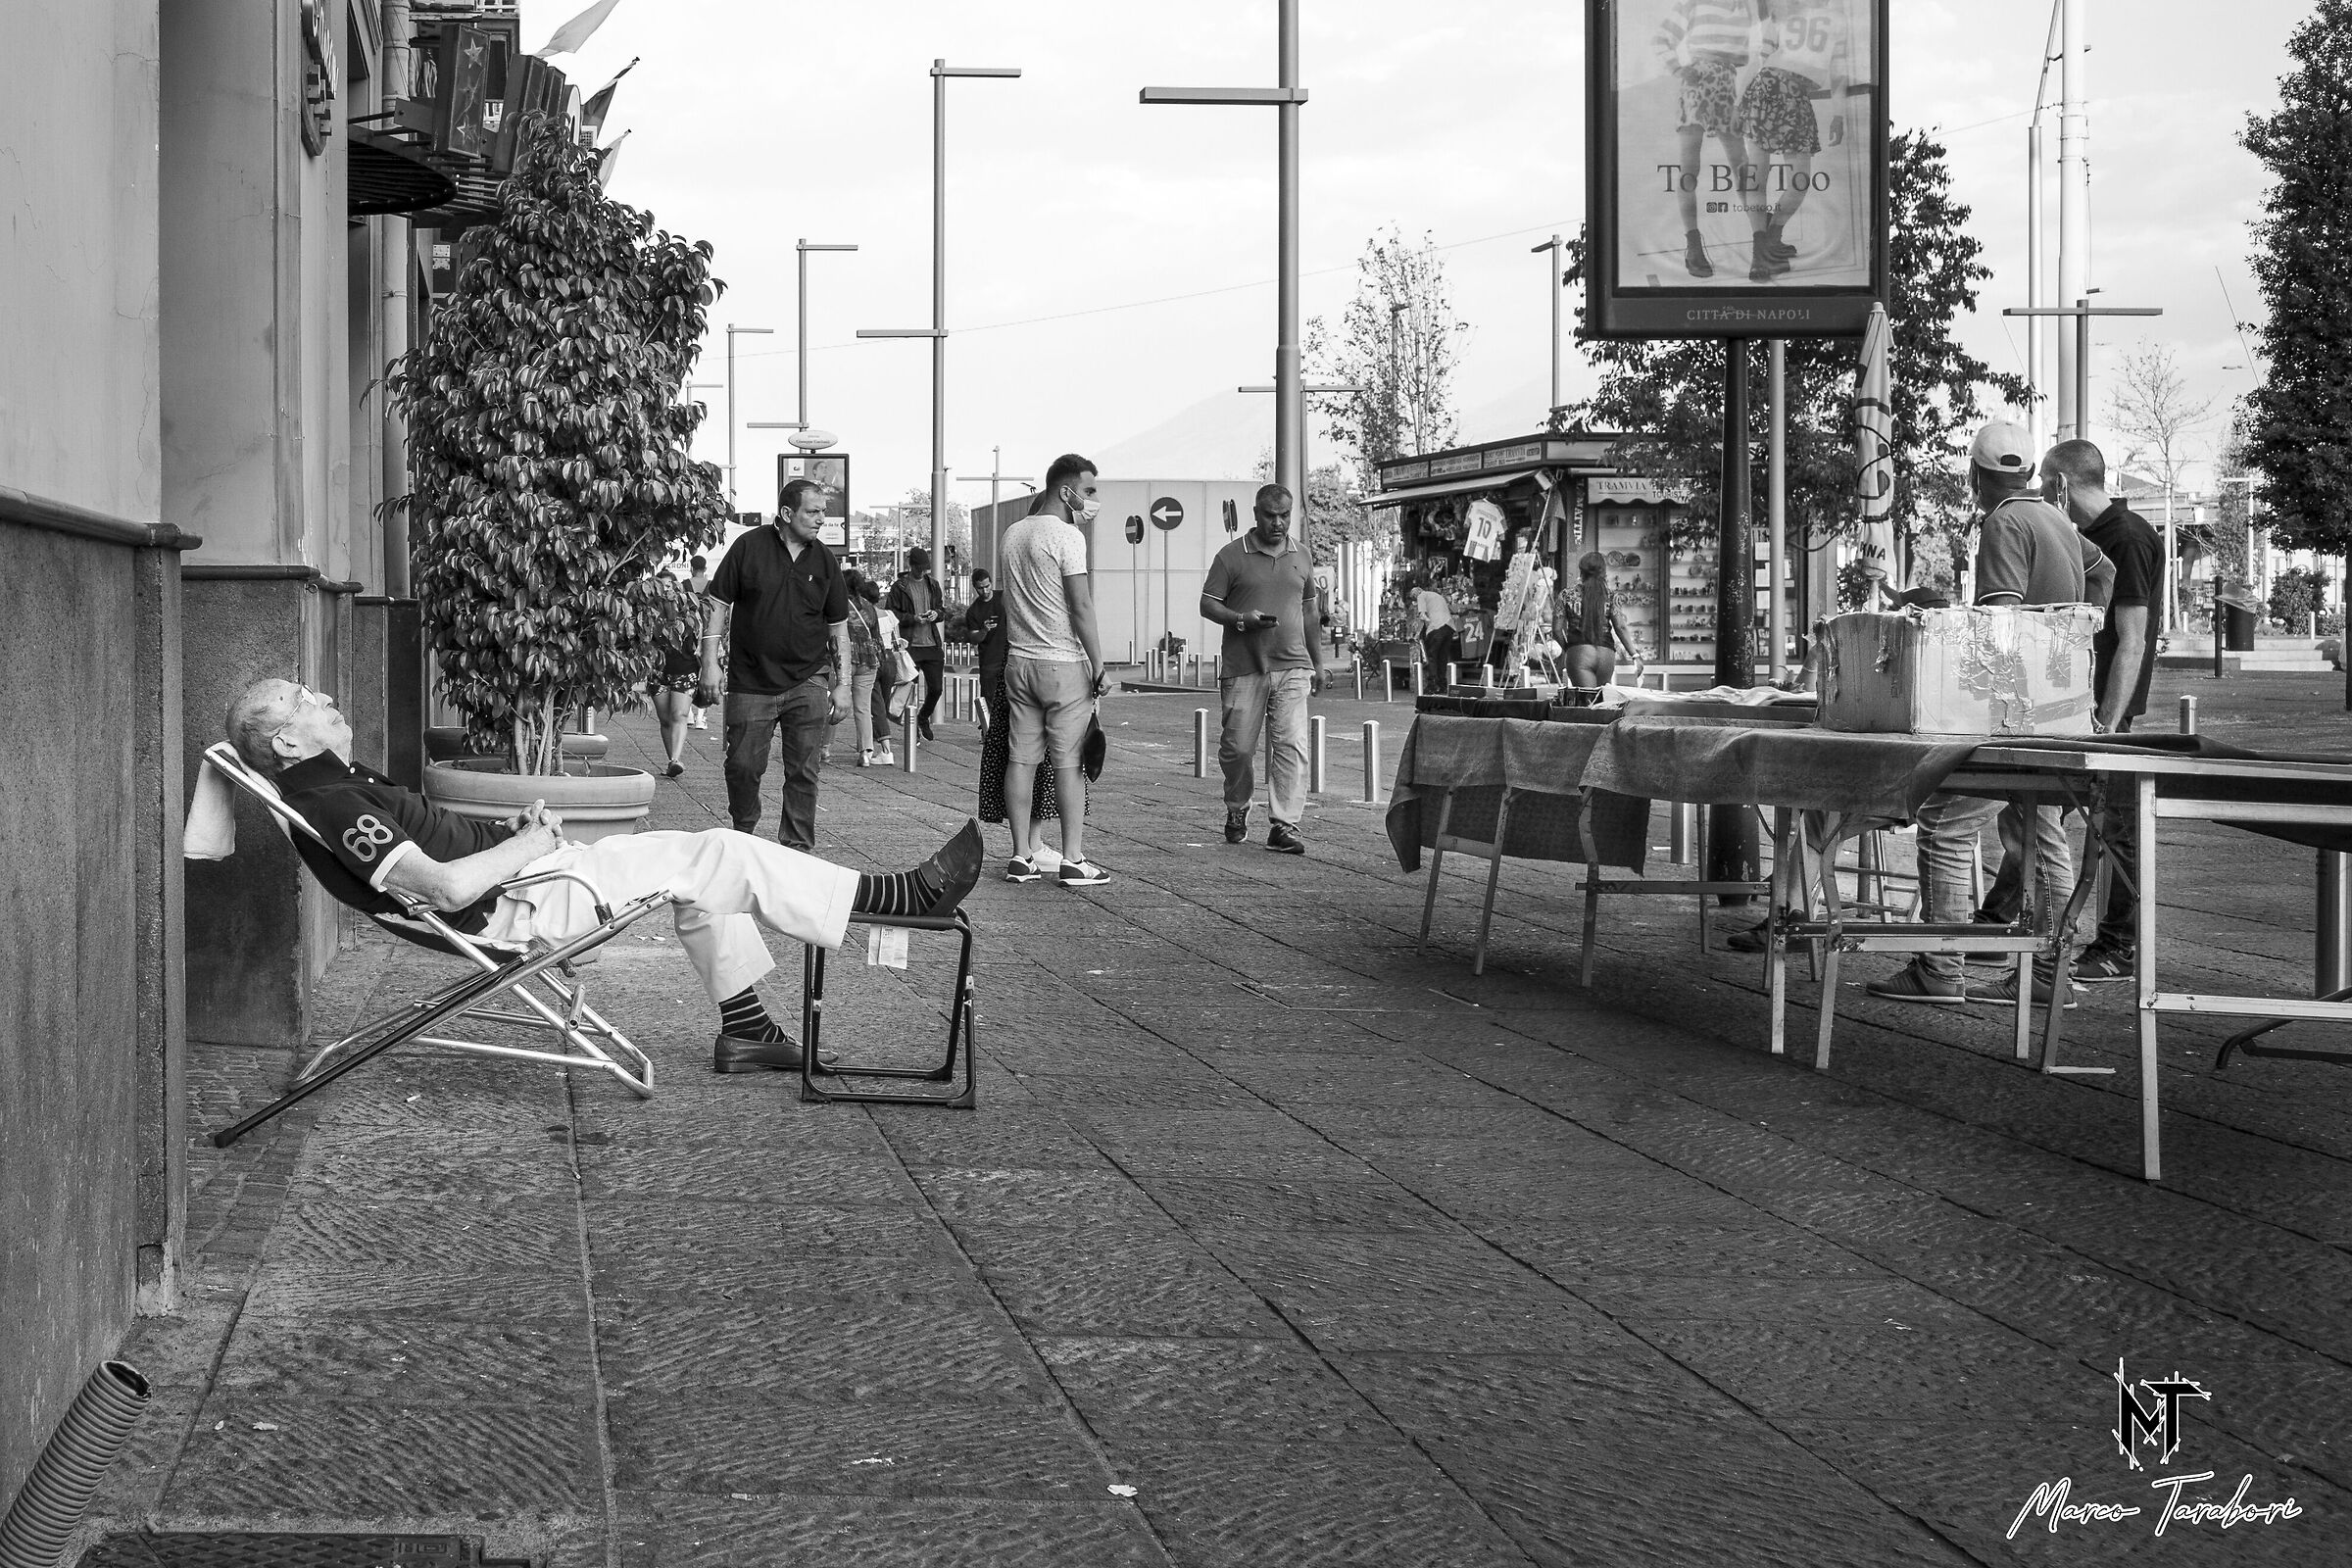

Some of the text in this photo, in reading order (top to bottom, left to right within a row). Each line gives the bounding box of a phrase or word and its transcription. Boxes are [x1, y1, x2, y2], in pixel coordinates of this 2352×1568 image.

[1786, 16, 1831, 53] 96
[1657, 164, 1831, 192] To BE Too
[1733, 202, 1782, 213] tobetoo.it
[1736, 310, 1750, 320] DI
[1757, 309, 1810, 320] NAPOLI
[1597, 481, 1646, 491] TRAMVIA
[1477, 516, 1492, 539] 10
[1463, 620, 1484, 643] 24
[343, 814, 393, 861] 68
